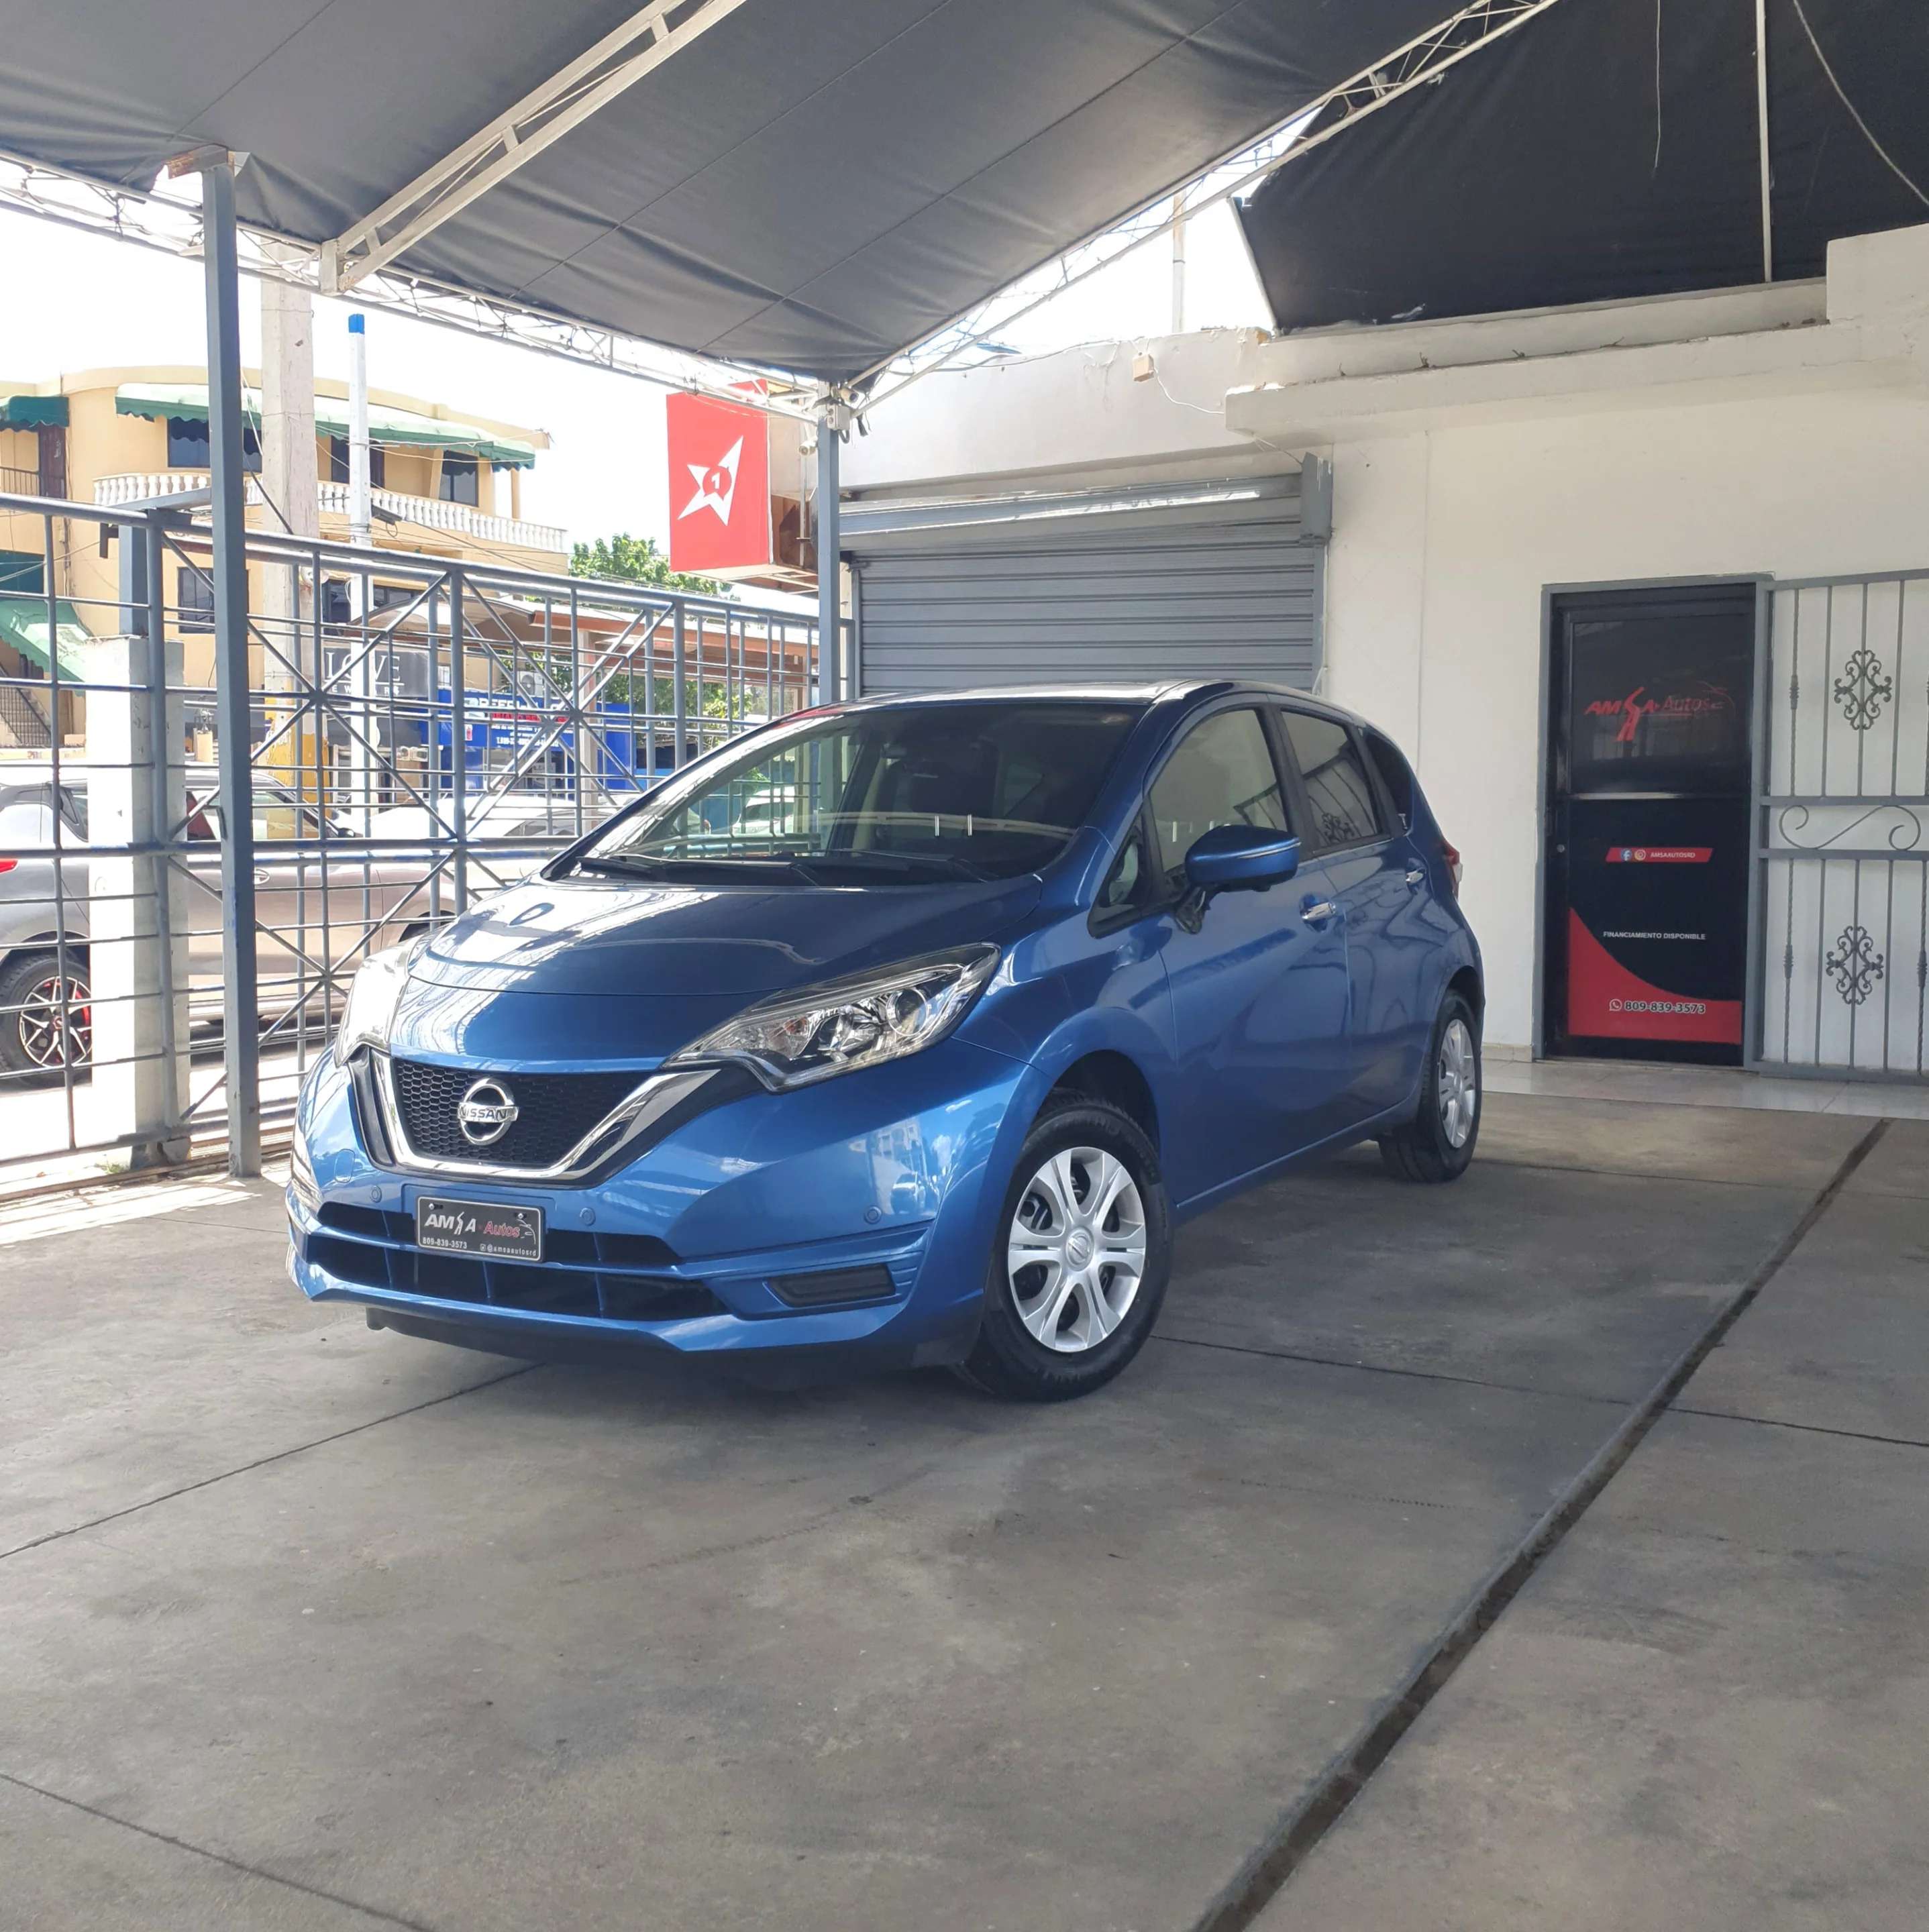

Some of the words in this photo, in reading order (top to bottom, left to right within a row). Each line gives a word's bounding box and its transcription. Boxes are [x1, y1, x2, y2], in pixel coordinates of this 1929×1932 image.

[1603, 930, 1662, 939] FINANCIAMIENTO
[1624, 1000, 1707, 1014] 809-839-3573
[459, 1105, 507, 1120] NISSAN
[424, 1211, 477, 1236] AMSA
[483, 1220, 521, 1238] Autos
[422, 1236, 468, 1250] 809-839-3573
